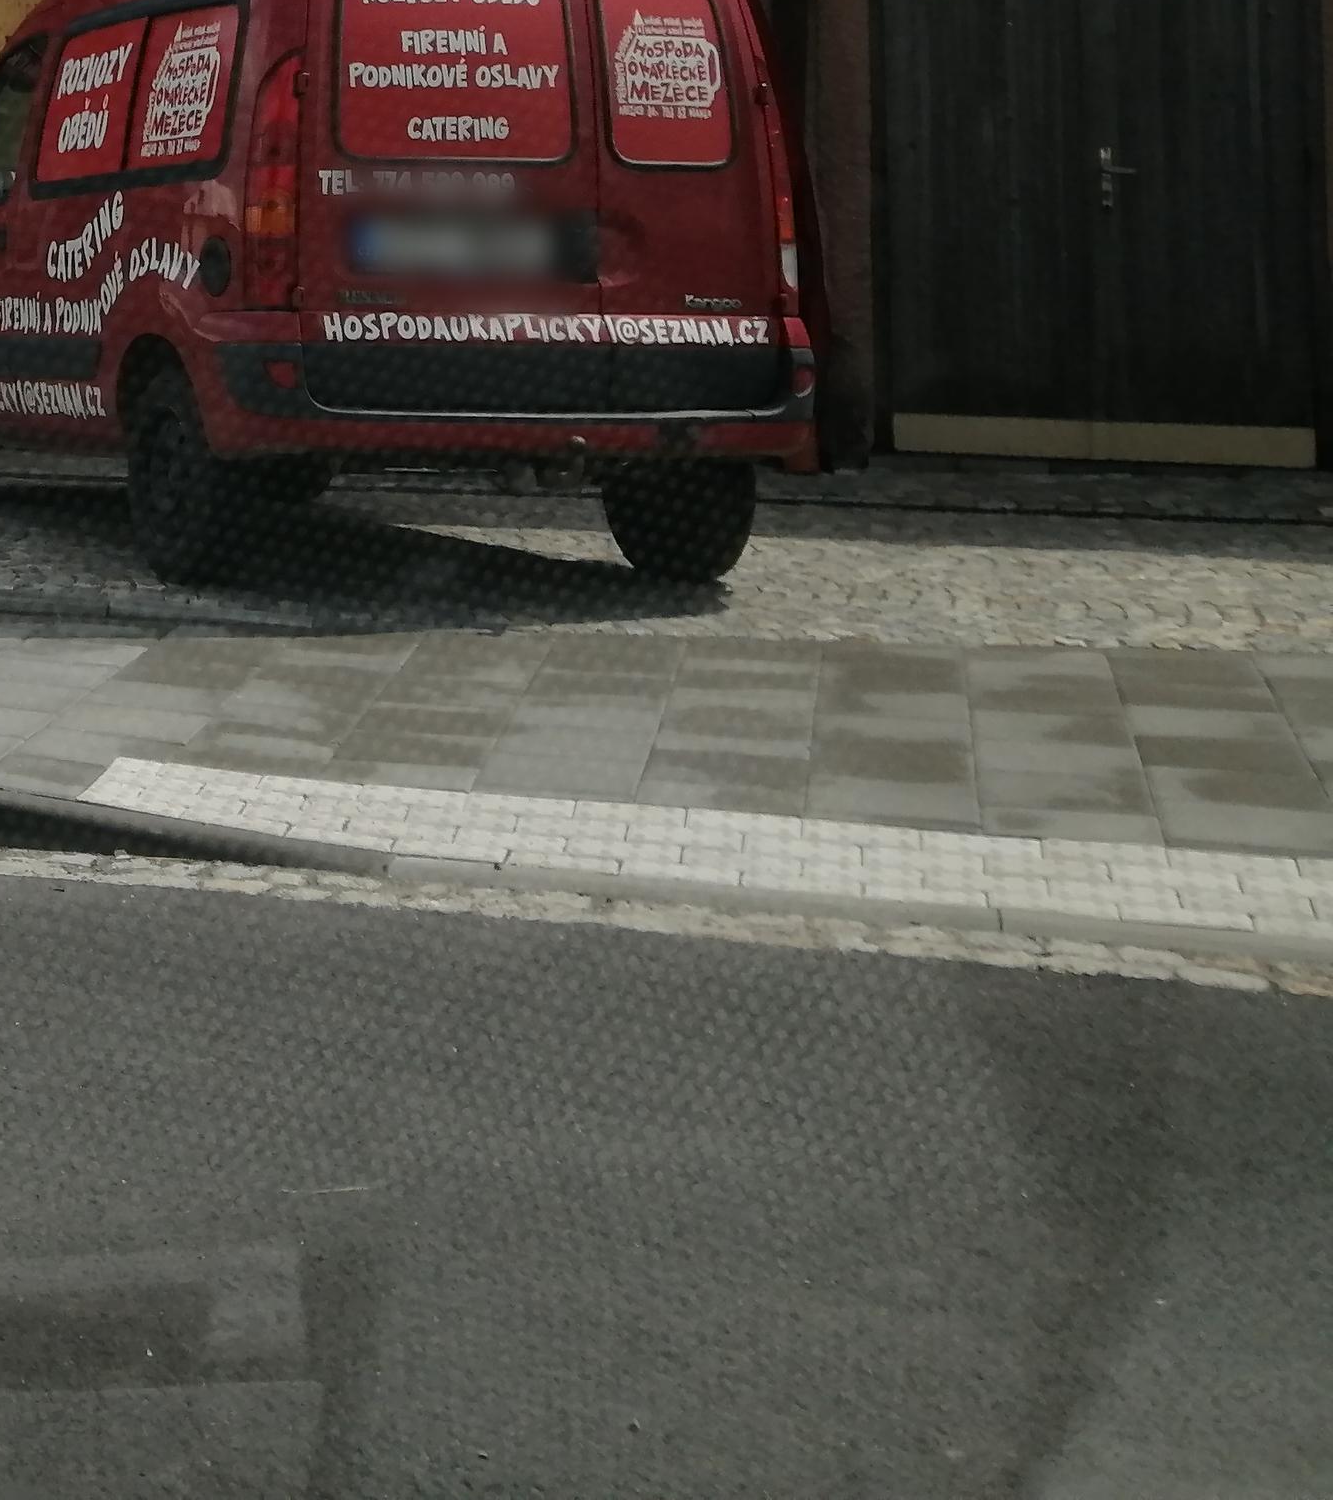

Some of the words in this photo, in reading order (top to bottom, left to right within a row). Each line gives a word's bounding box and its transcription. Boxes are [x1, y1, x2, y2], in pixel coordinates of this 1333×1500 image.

[401, 25, 486, 55] FIREMNÍ
[493, 33, 508, 55] A
[57, 42, 133, 100] ROZVOZY
[349, 58, 468, 90] PODNIKOVÉ
[476, 63, 559, 90] OSLAVY
[58, 94, 109, 154] OBĚDŮ
[407, 116, 510, 142] CATERING
[47, 190, 123, 283] CATERING
[43, 303, 52, 334] A
[55, 251, 124, 336] PODNIKOVÉ
[129, 237, 201, 290] OSLAVY
